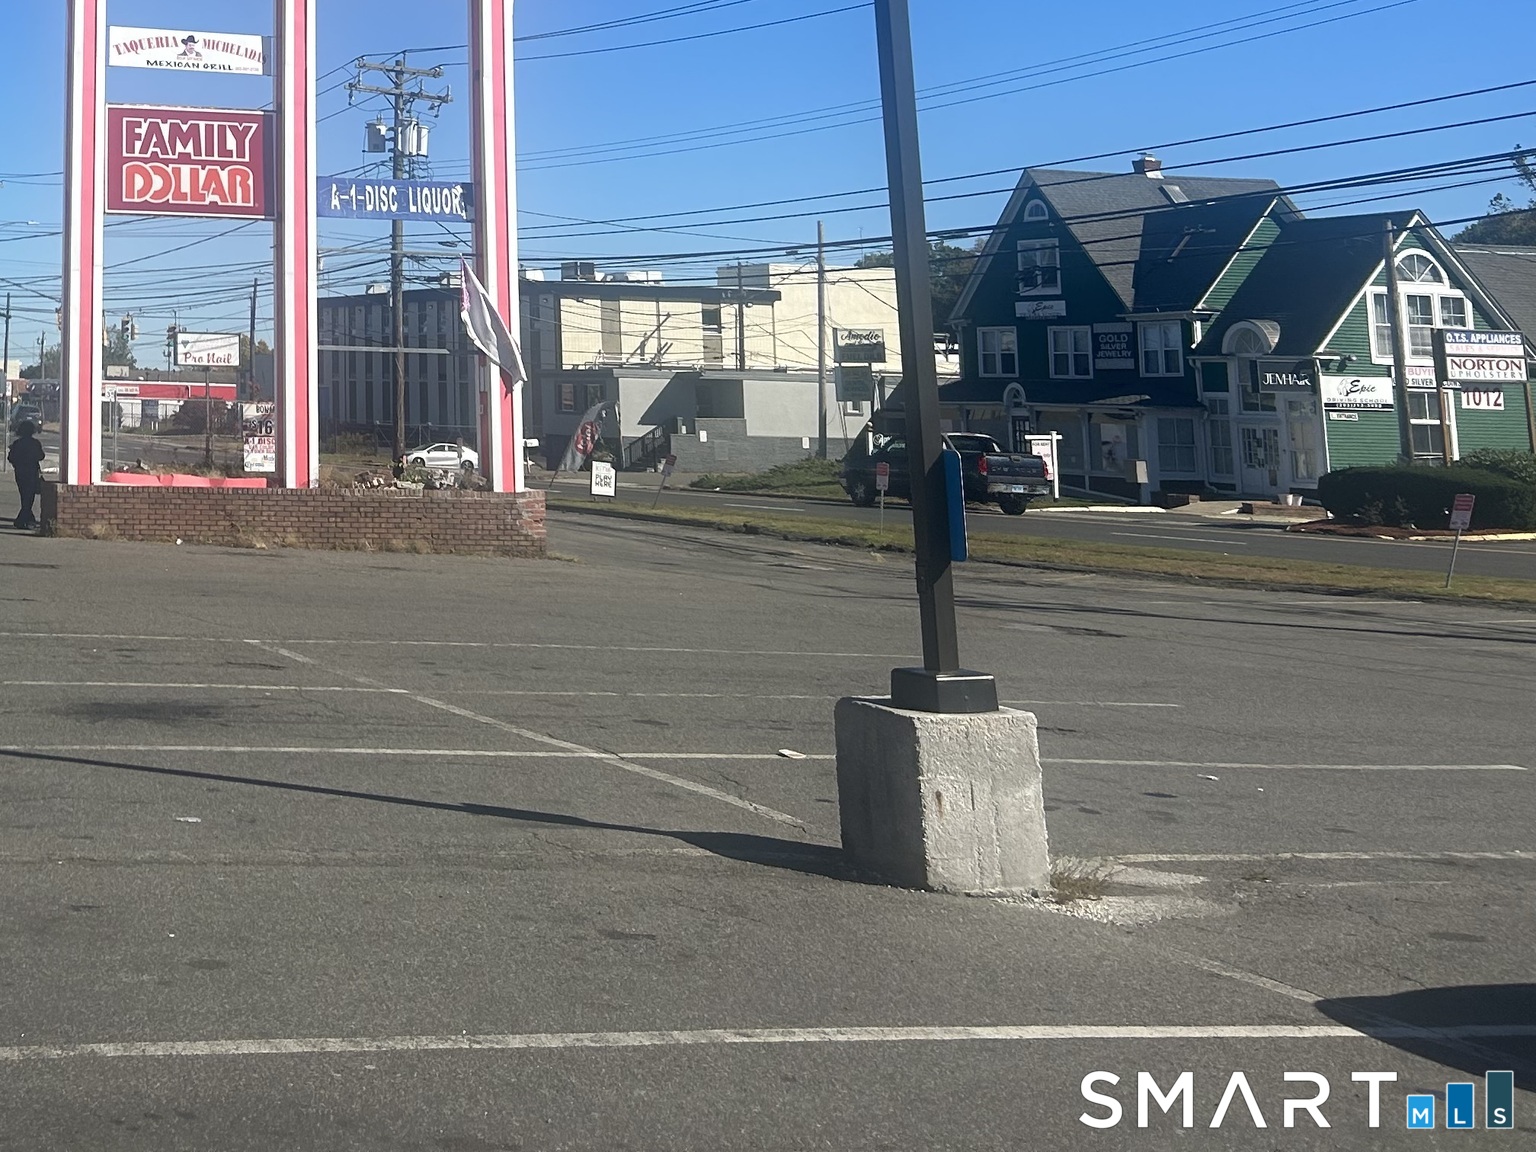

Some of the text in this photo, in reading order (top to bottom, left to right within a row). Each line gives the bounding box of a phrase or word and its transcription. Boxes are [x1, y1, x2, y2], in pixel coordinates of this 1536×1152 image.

[113, 36, 267, 65] TAQUERIA MICHELADAS
[146, 59, 200, 69] MEXICAN
[203, 62, 234, 71] GRILL
[123, 117, 259, 162] FAMILY
[123, 161, 254, 207] DOLLAR
[1098, 334, 1128, 343] GOLD
[1446, 333, 1521, 344] O.T.S. APPLIANCES
[183, 351, 232, 364] Pro Nail
[1097, 350, 1132, 358] JEWELRY
[1450, 358, 1522, 371] NORTON
[1408, 367, 1434, 376] BUYI
[1450, 370, 1524, 379] UPHOLSTERY
[1347, 379, 1377, 397] Epic
[1411, 378, 1434, 386] SILVER
[1463, 388, 1503, 407] 1012
